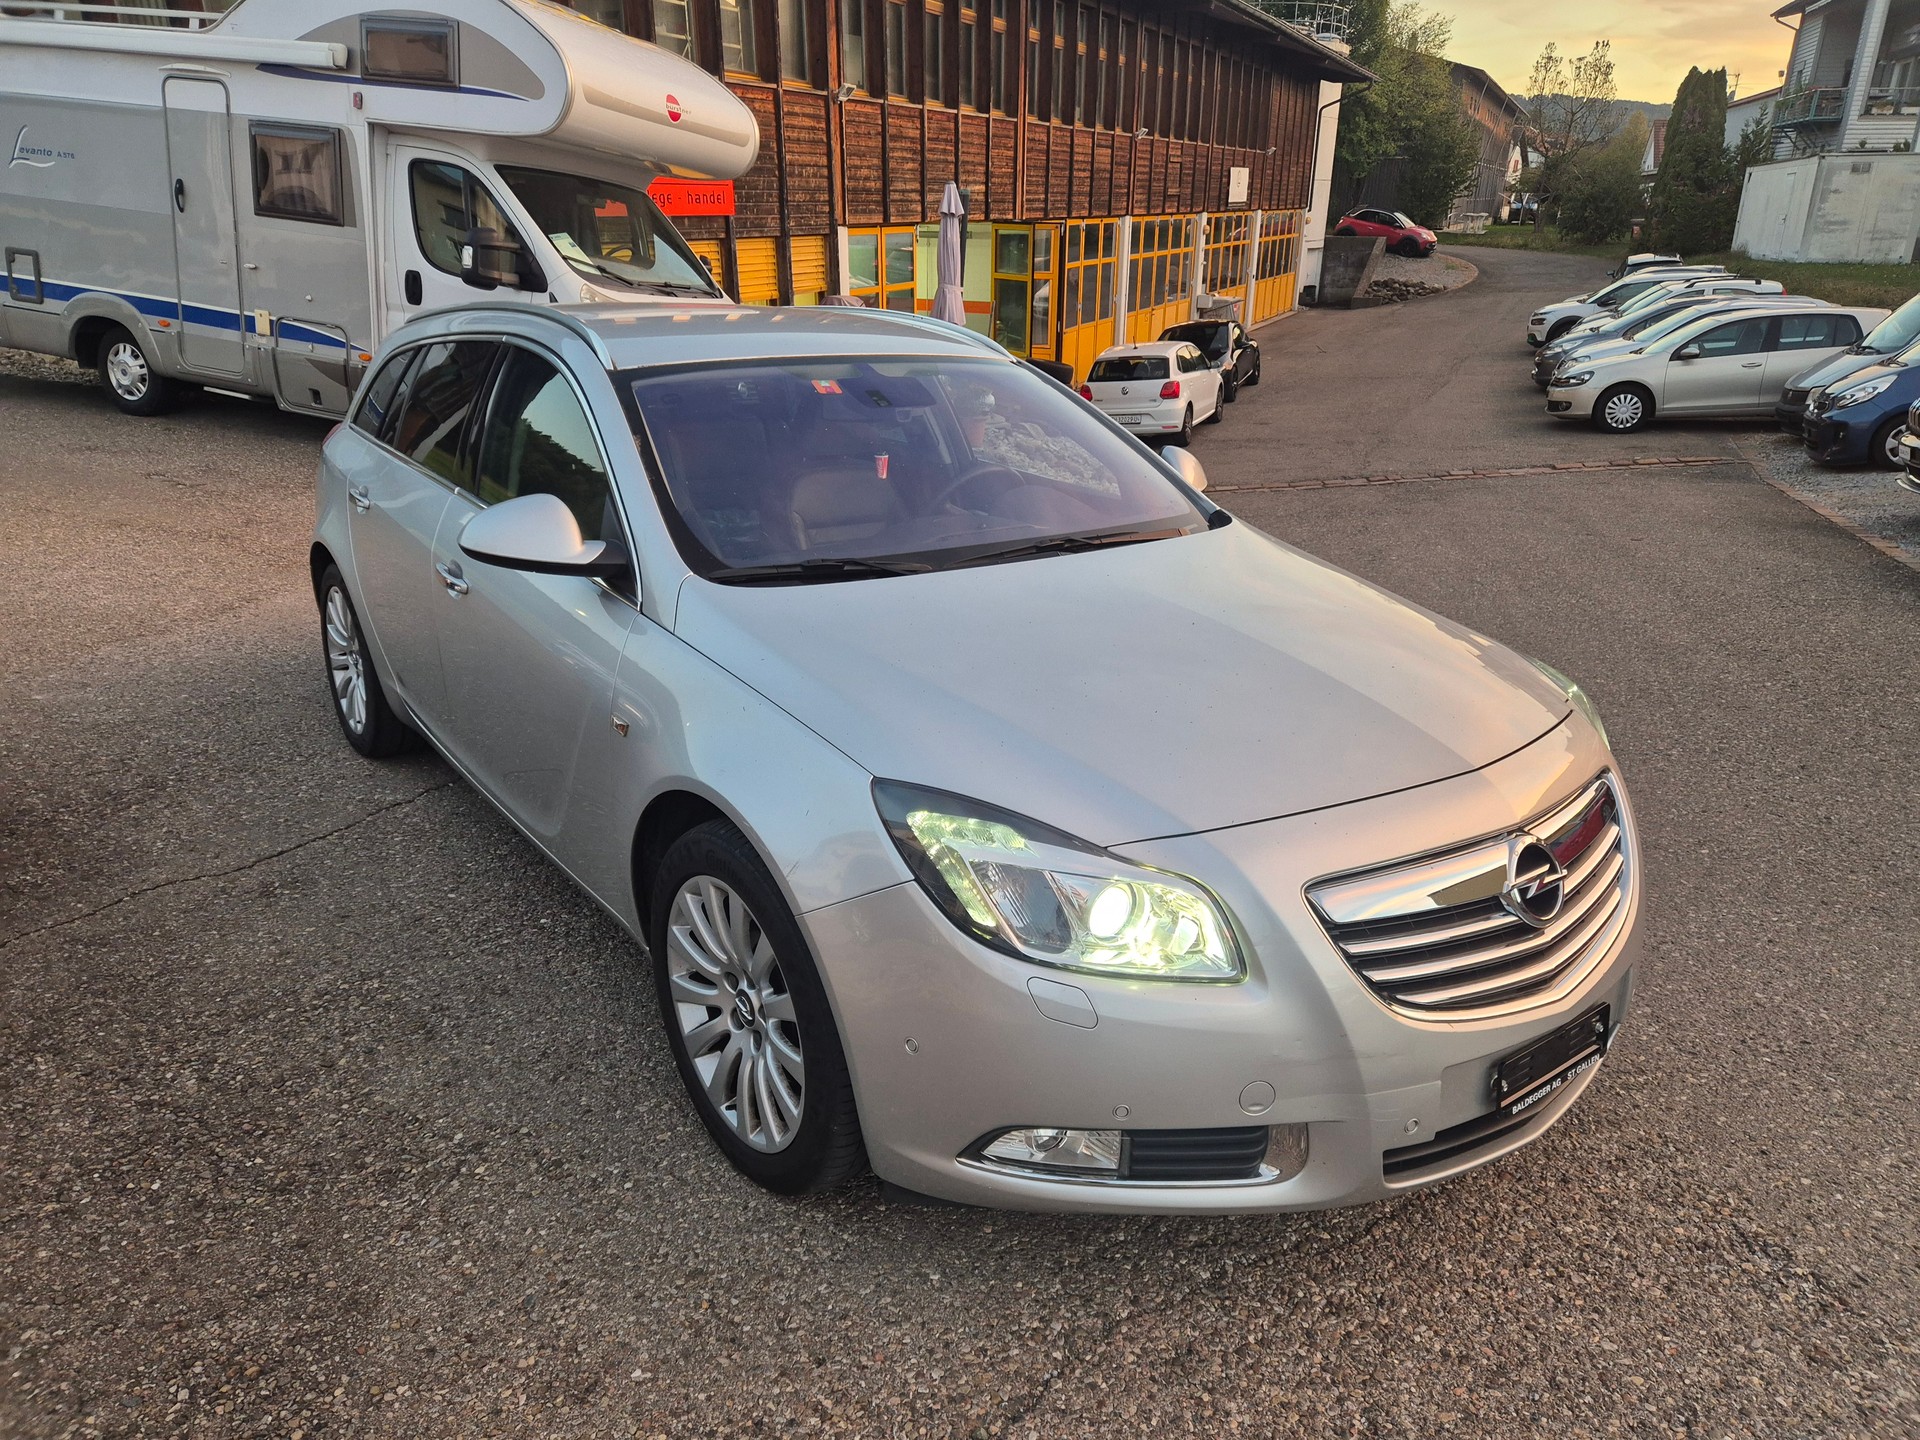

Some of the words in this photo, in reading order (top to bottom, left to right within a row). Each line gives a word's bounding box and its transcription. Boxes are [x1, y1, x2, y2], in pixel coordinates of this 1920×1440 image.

[687, 190, 726, 205] handel
[1512, 1085, 1551, 1115] BALDEGGER
[1551, 1078, 1562, 1090] AG
